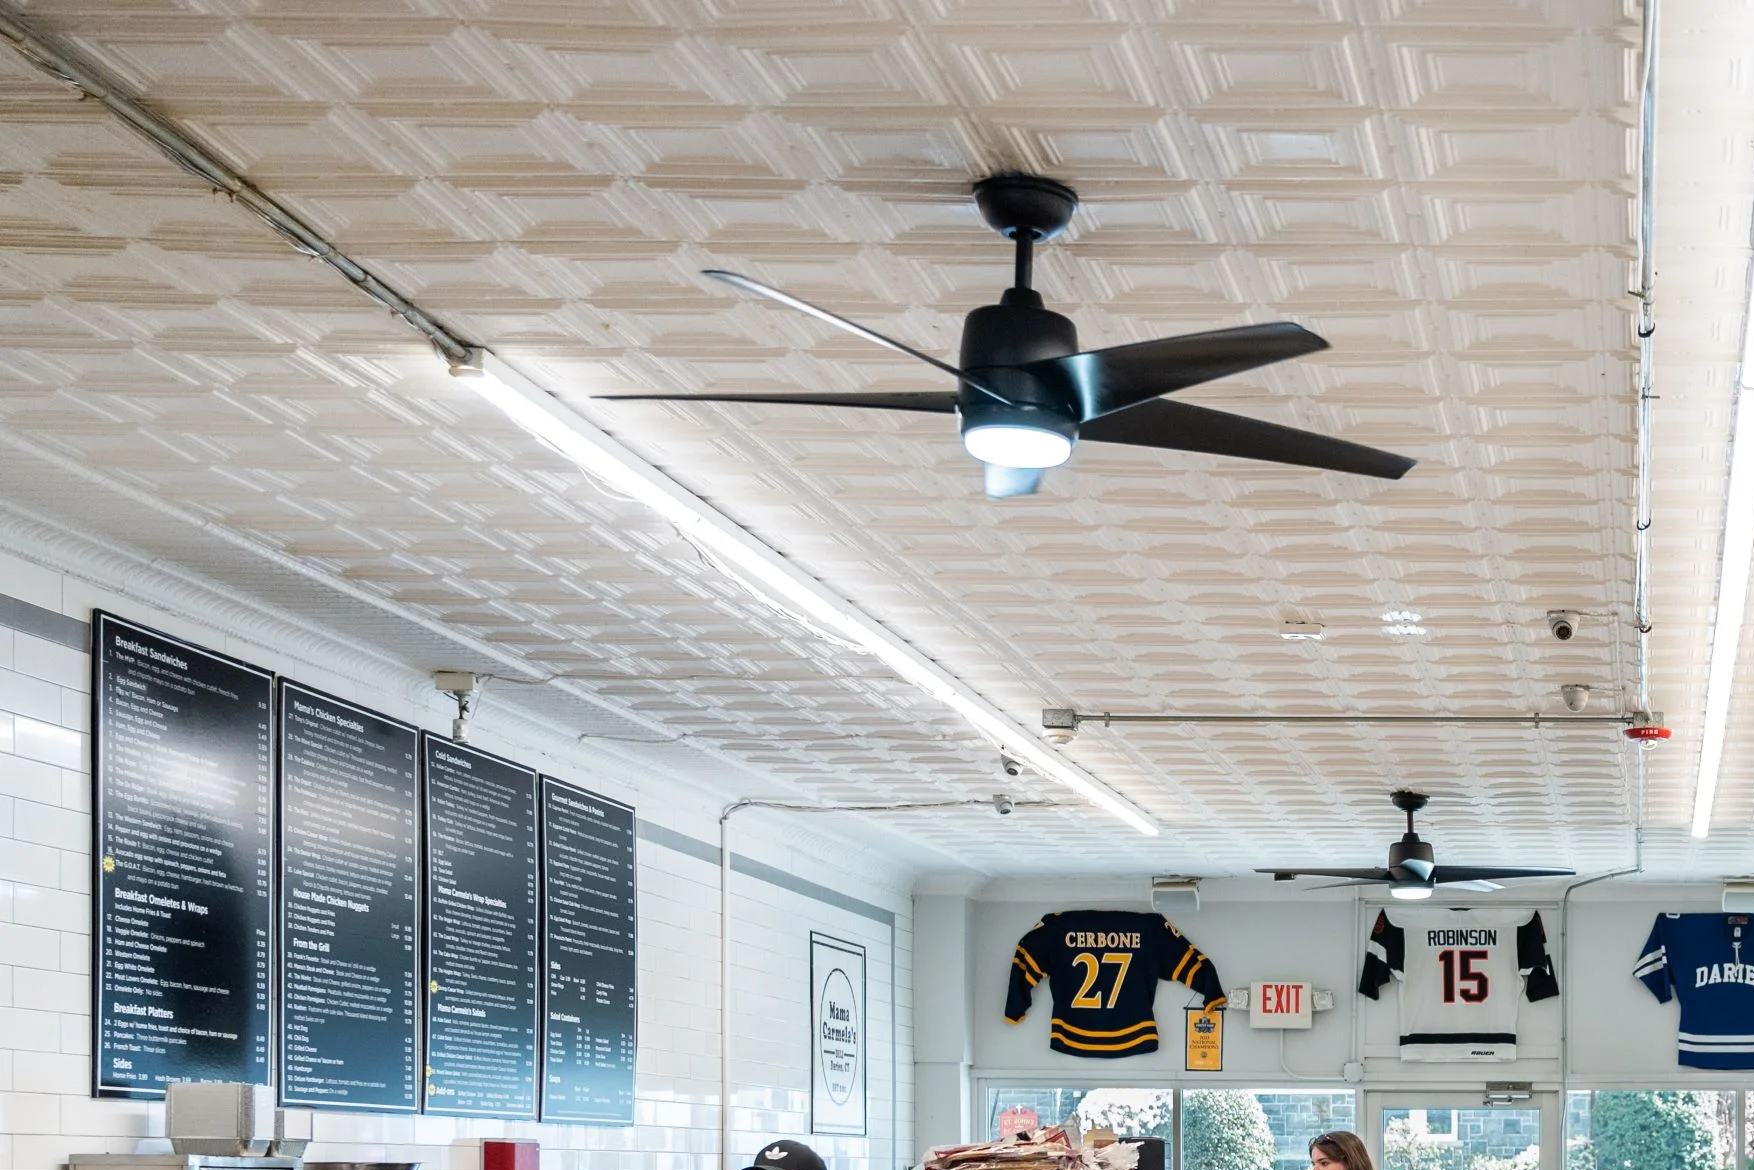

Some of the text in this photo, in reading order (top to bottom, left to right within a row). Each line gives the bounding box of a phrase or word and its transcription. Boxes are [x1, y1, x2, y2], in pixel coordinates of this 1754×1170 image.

[115, 635, 187, 671] Breakfast Sandwiches
[316, 708, 336, 724] Chicken
[115, 887, 208, 915] Breakfast Omeletes & Wraps
[293, 887, 369, 913] House Made Chicken Nuggets
[293, 937, 329, 952] From the Grill
[1065, 932, 1140, 948] CERBONE
[1428, 930, 1496, 946] ROBINSON
[1071, 953, 1132, 1008] 27
[1438, 950, 1488, 1004] 15
[114, 1002, 173, 1018] Breakfast Platters
[1263, 985, 1303, 1014] EXIT
[830, 1000, 850, 1022] Mama
[822, 1021, 856, 1044] Carmela's
[113, 1057, 132, 1069] Sides
